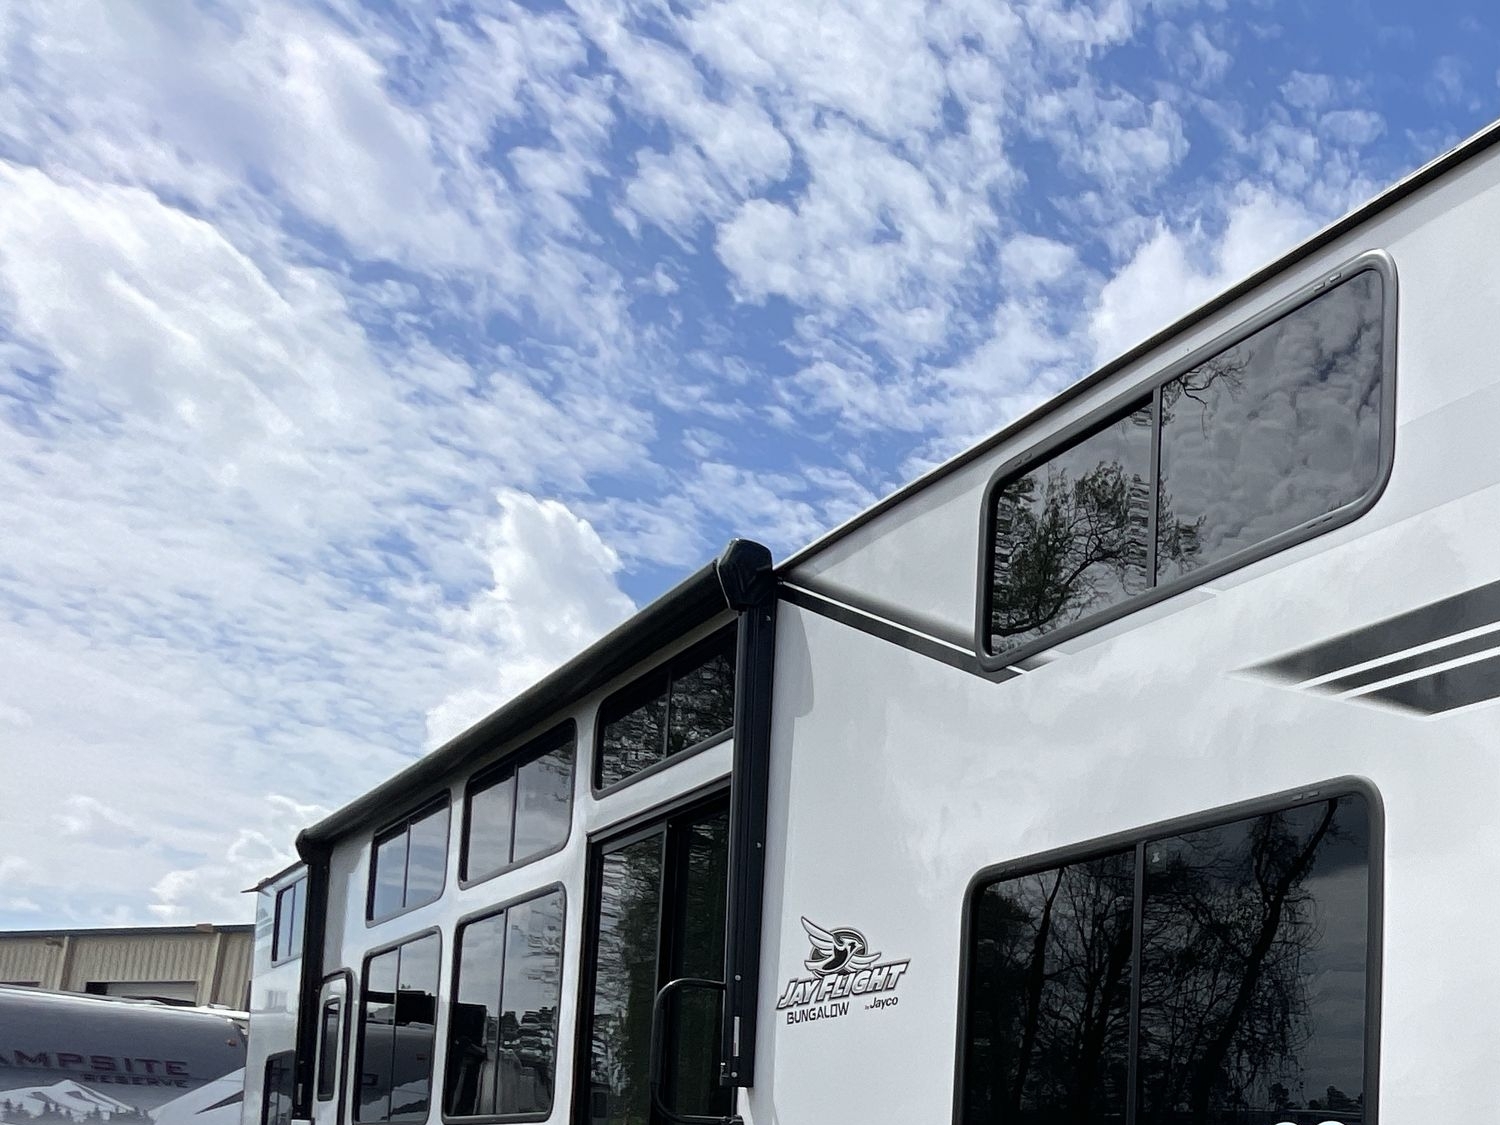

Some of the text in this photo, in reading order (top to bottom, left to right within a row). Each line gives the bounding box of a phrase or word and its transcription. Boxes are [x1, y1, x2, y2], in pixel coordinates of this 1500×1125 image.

[786, 1001, 849, 1024] BUNGALOW
[870, 996, 898, 1010] Jayco
[0, 1050, 190, 1076] MPSITE
[83, 1073, 188, 1089] RESERVE
